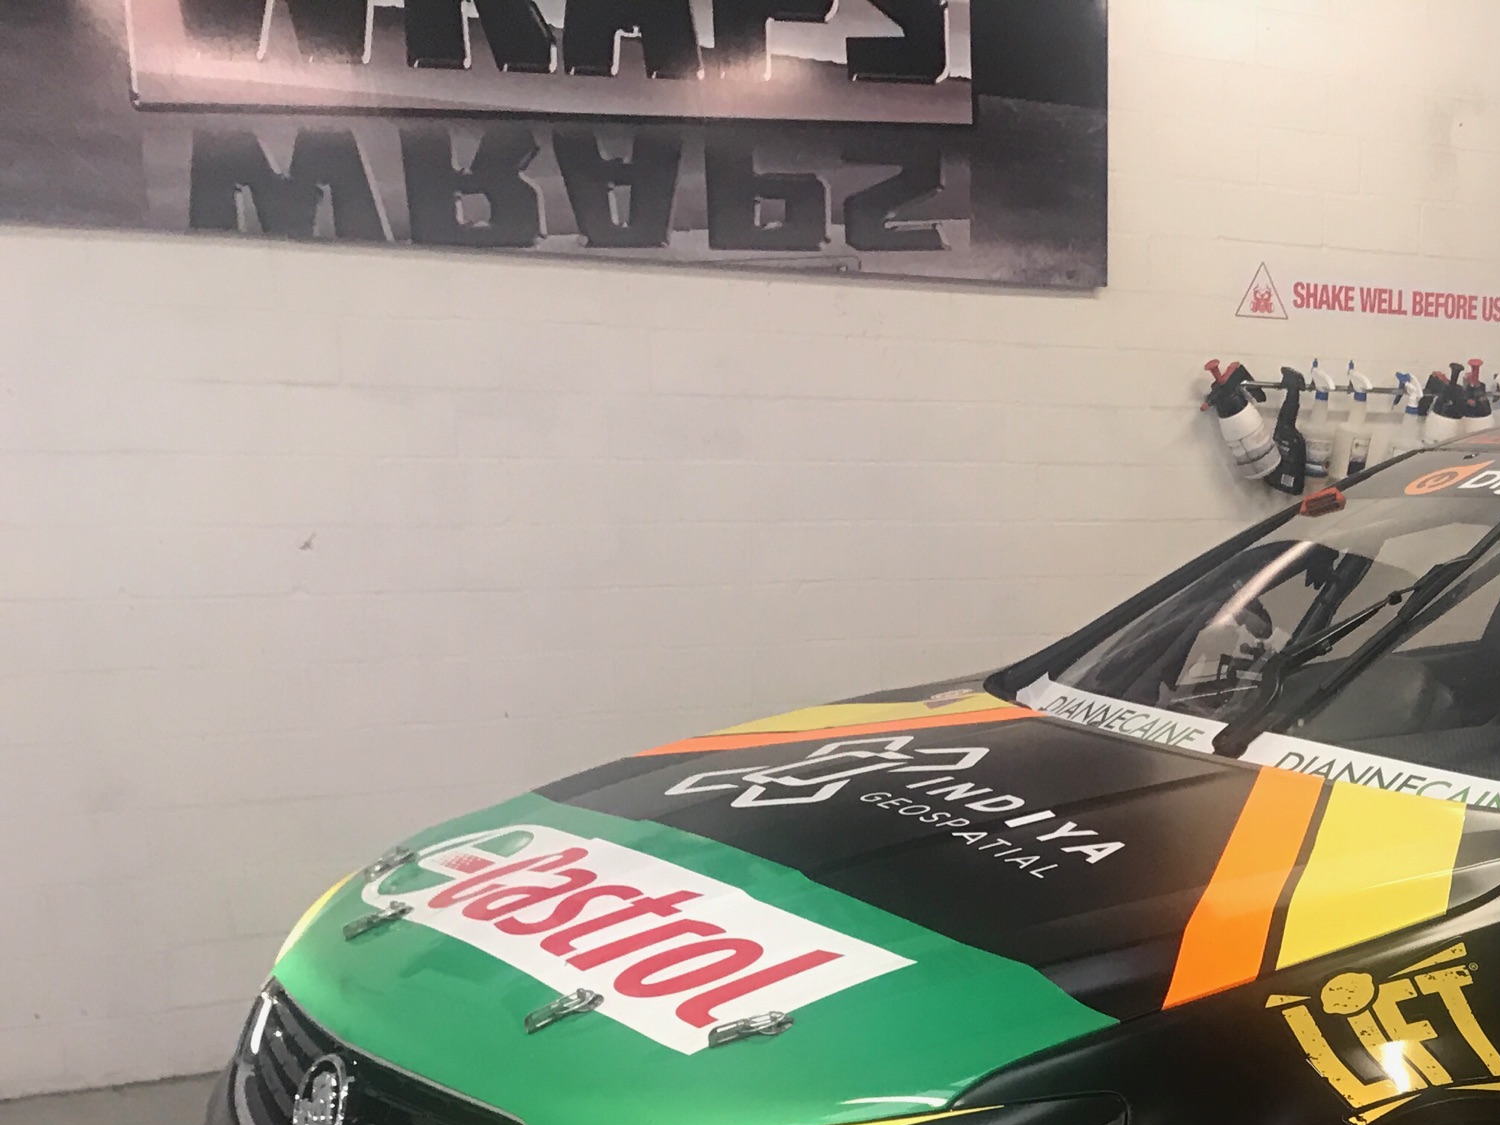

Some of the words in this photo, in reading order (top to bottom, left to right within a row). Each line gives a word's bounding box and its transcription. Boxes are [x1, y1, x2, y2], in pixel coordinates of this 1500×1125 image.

[1292, 281, 1355, 313] SHAKE
[1360, 287, 1408, 316] WELL
[1412, 290, 1478, 322] BEFORE
[859, 791, 1059, 879] GEOSPATIAL
[906, 776, 1126, 864] INDIYA
[428, 846, 846, 1029] Castrol
